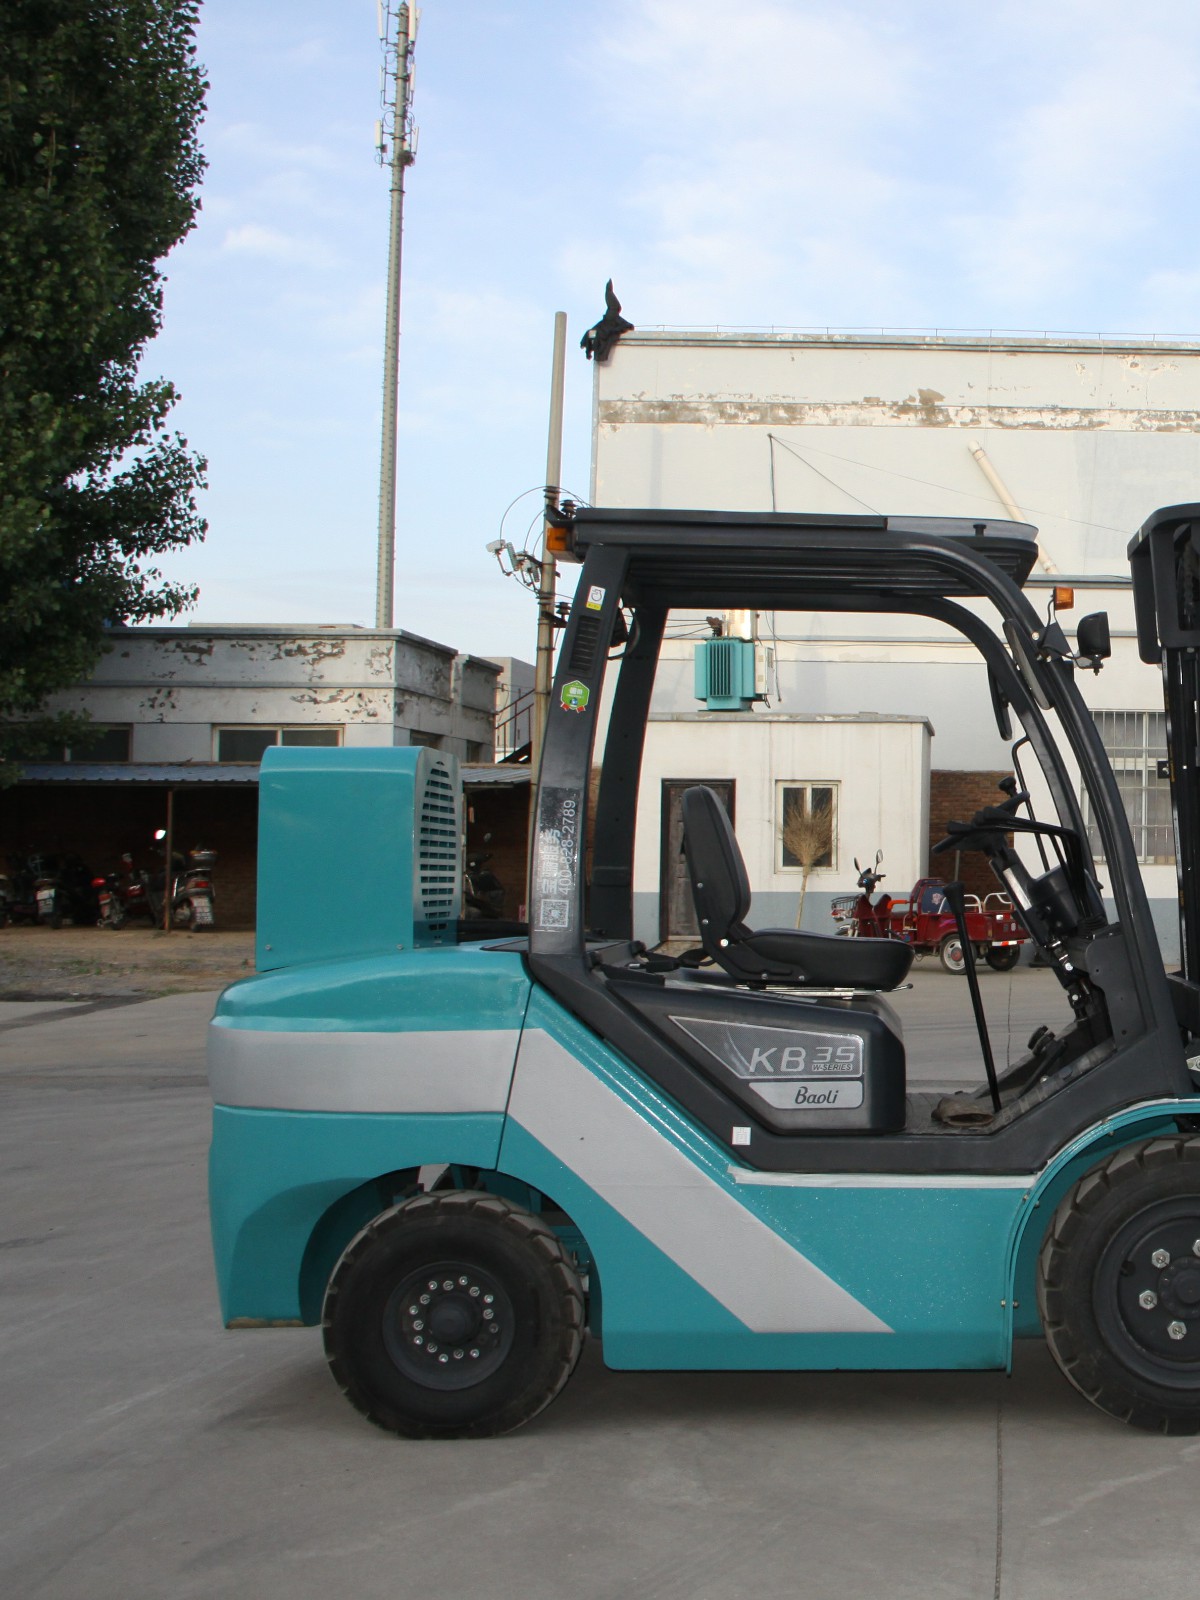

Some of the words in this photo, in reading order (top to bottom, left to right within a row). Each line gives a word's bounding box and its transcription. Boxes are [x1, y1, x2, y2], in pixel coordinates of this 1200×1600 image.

[559, 800, 576, 895] 400-828-2789
[748, 1047, 807, 1073] KB
[813, 1064, 852, 1072] W-SERIES
[794, 1086, 839, 1105] Baoli
